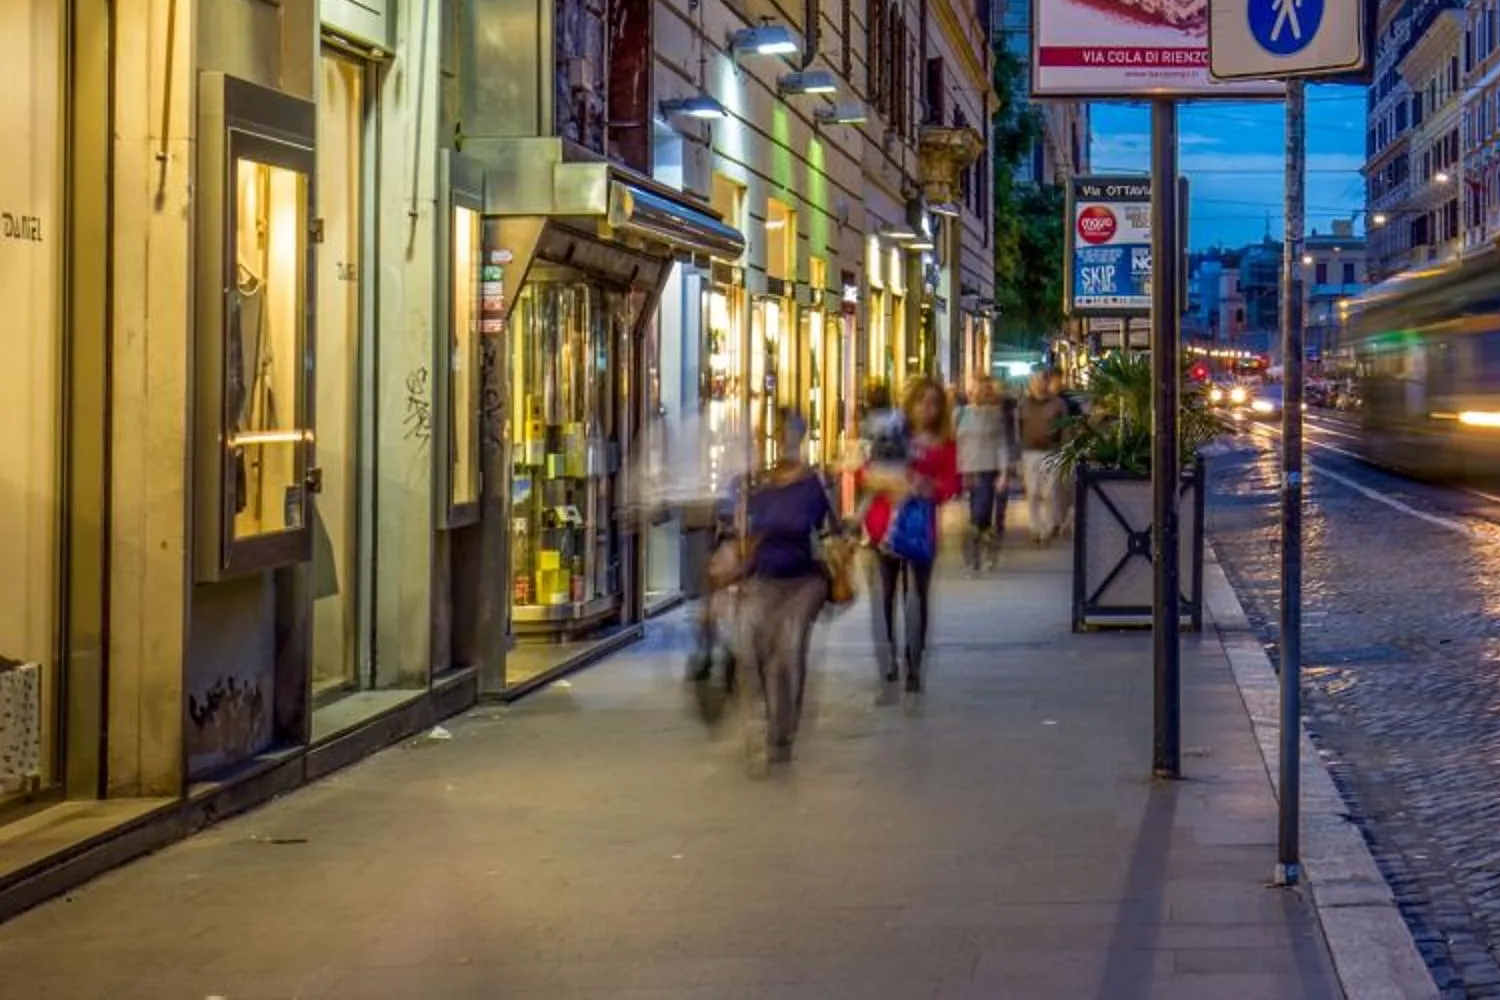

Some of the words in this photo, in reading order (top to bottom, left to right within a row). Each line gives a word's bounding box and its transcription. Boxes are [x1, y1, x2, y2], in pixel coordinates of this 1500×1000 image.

[1083, 50, 1105, 63] VIA
[1107, 50, 1142, 63] COLA
[1145, 50, 1159, 63] DI
[1081, 185, 1100, 197] Via
[1081, 265, 1116, 285] SKIP
